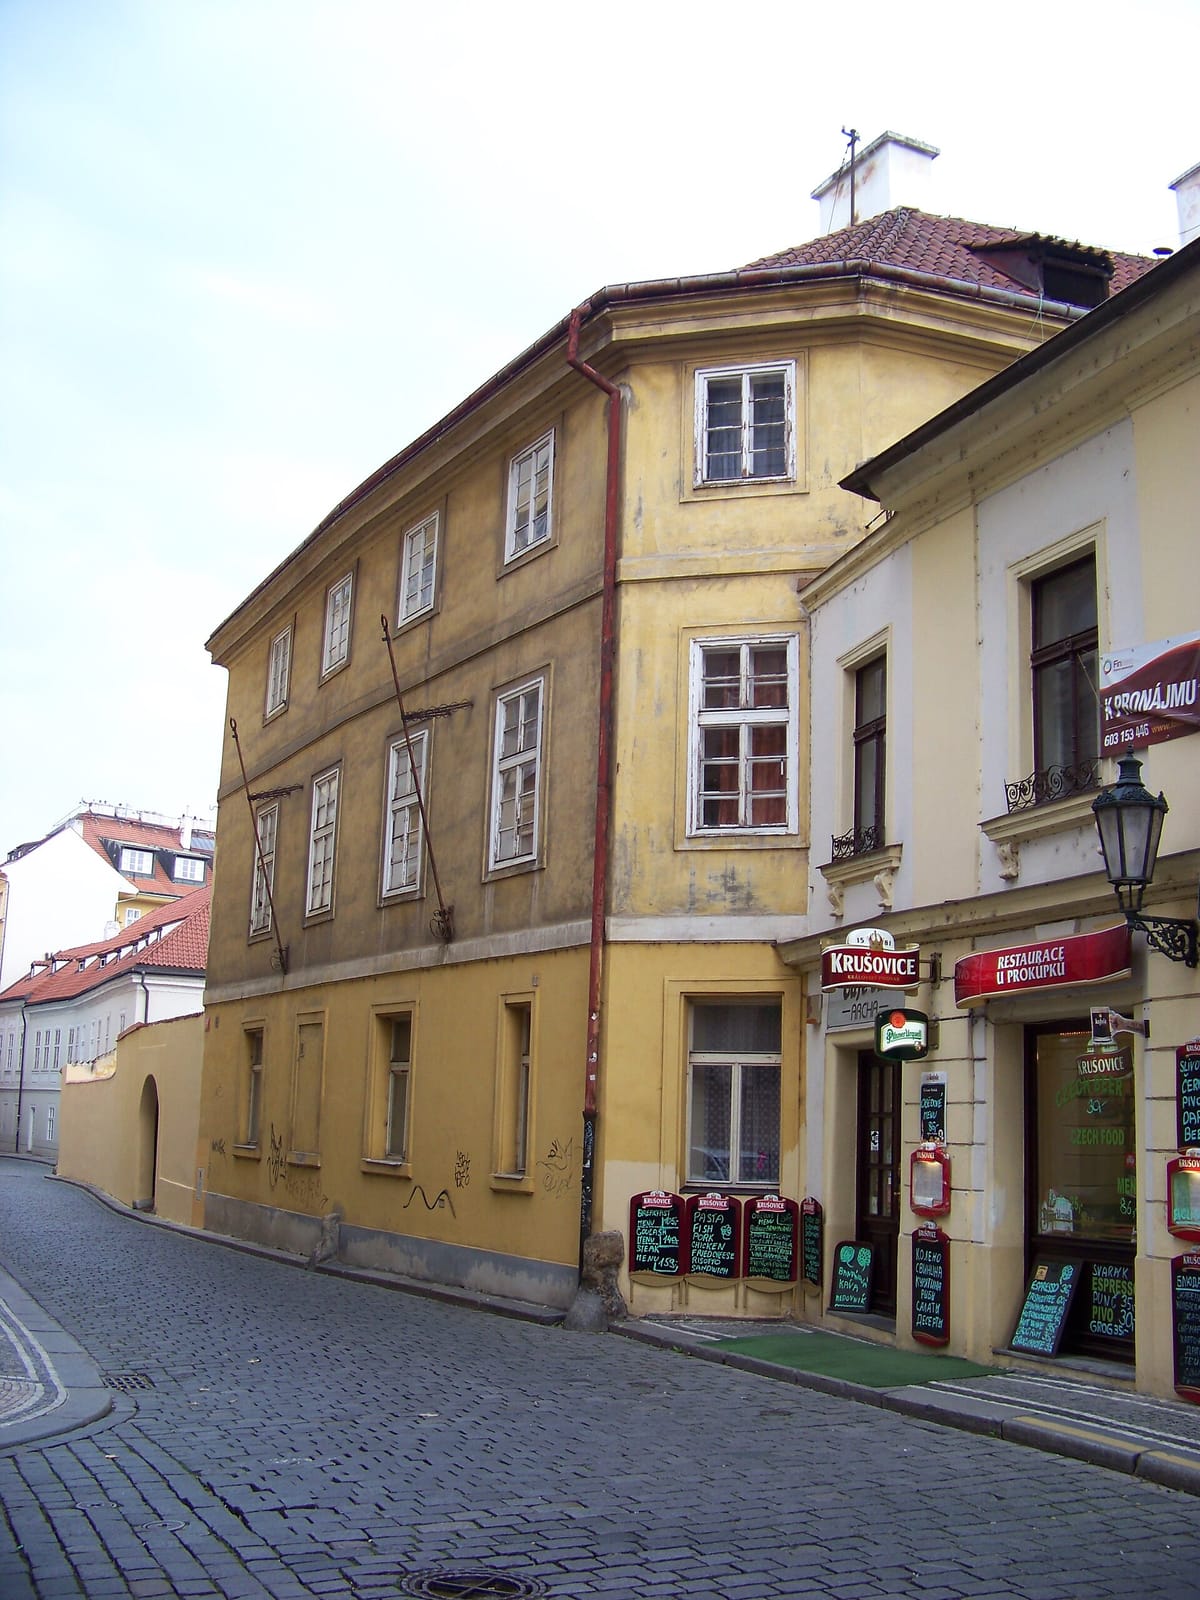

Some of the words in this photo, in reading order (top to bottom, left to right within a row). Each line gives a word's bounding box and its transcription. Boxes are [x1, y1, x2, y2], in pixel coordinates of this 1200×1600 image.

[1104, 696, 1113, 720] K
[1114, 679, 1197, 718] PRONÁJMU
[1104, 732, 1119, 747] 603
[1120, 728, 1134, 743] 153
[1136, 723, 1150, 738] 446
[831, 951, 916, 975] KRUŠOVICE
[997, 946, 1065, 969] RESTAURACE
[996, 971, 1004, 985] U
[886, 1028, 906, 1044] Pilsner
[905, 1029, 922, 1040] Urquell
[1078, 1056, 1124, 1075] KRUŠOVICE
[1071, 1127, 1099, 1146] CZECH
[1100, 1128, 1125, 1146] FOOD
[699, 1199, 728, 1207] KRUŠOVICE
[756, 1201, 784, 1209] KRUŠOVICE
[693, 1212, 725, 1224] PASTA
[692, 1223, 714, 1234] FISH
[636, 1236, 655, 1244] MENU
[692, 1232, 714, 1242] PORK
[636, 1245, 660, 1254] STEAK
[691, 1241, 726, 1251] CHICKEN
[636, 1254, 660, 1263] MENU
[691, 1249, 712, 1258] FRIED
[915, 1247, 942, 1262] КОЛЕНО
[692, 1256, 721, 1265] RISOTTO
[691, 1265, 729, 1275] SANDWICH
[1092, 1305, 1114, 1322] PIVO
[1090, 1320, 1113, 1335] GROG
